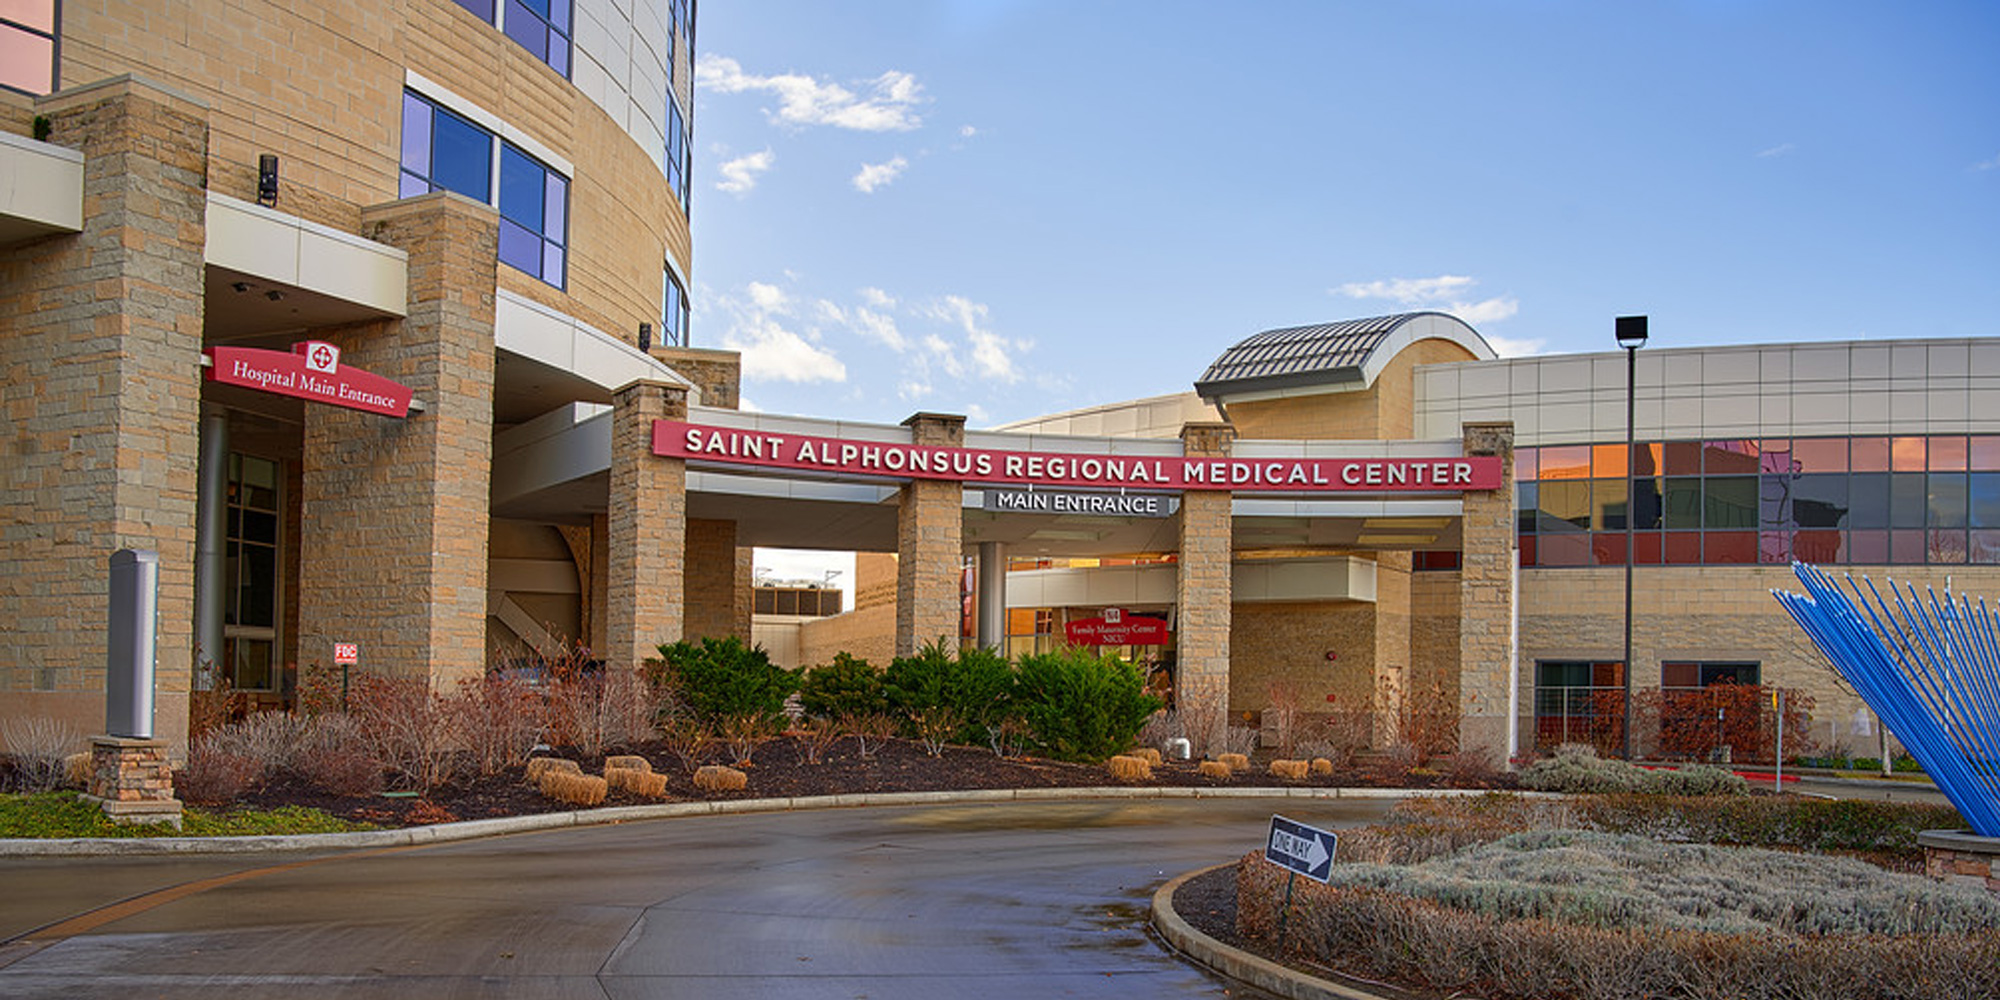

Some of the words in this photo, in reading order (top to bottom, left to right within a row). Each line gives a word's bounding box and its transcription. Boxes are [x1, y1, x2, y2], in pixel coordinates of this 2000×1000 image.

[233, 360, 295, 388] Hospital
[299, 375, 336, 397] Main
[338, 383, 396, 409] Entrance
[685, 428, 784, 459] SAINT
[796, 439, 993, 476] ALPHONSUS
[1004, 455, 1170, 483] REGIONAL
[1183, 462, 1330, 486] MEDICAL
[1341, 462, 1473, 486] CENTER
[997, 492, 1047, 509] MAIN
[1053, 495, 1158, 513] ENTRANCE
[1072, 624, 1095, 636] Family
[1131, 624, 1157, 634] Center
[1274, 831, 1291, 852] ONE
[1290, 836, 1312, 859] WAY
